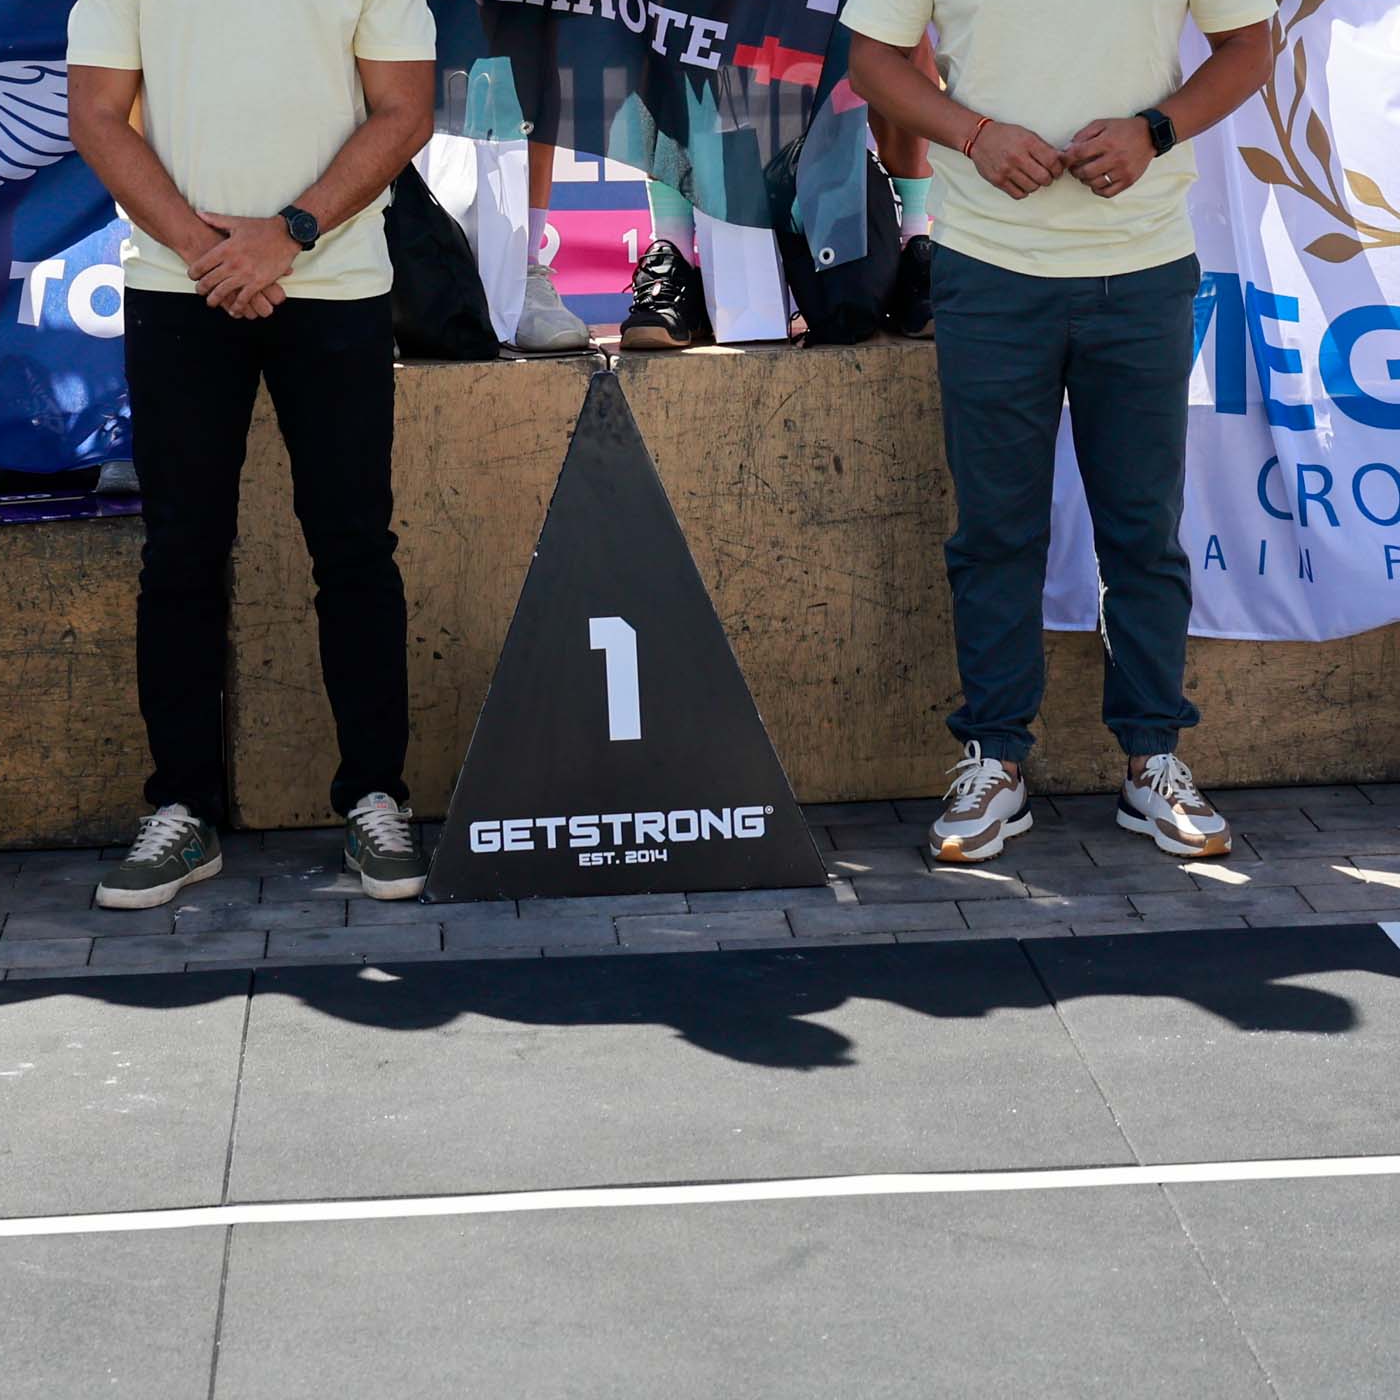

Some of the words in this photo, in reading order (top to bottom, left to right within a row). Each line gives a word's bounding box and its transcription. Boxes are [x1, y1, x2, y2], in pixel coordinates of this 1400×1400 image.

[588, 615, 642, 741] 1
[469, 806, 766, 854] GETSTRONG
[578, 851, 621, 867] EST.
[625, 848, 669, 864] 2014
